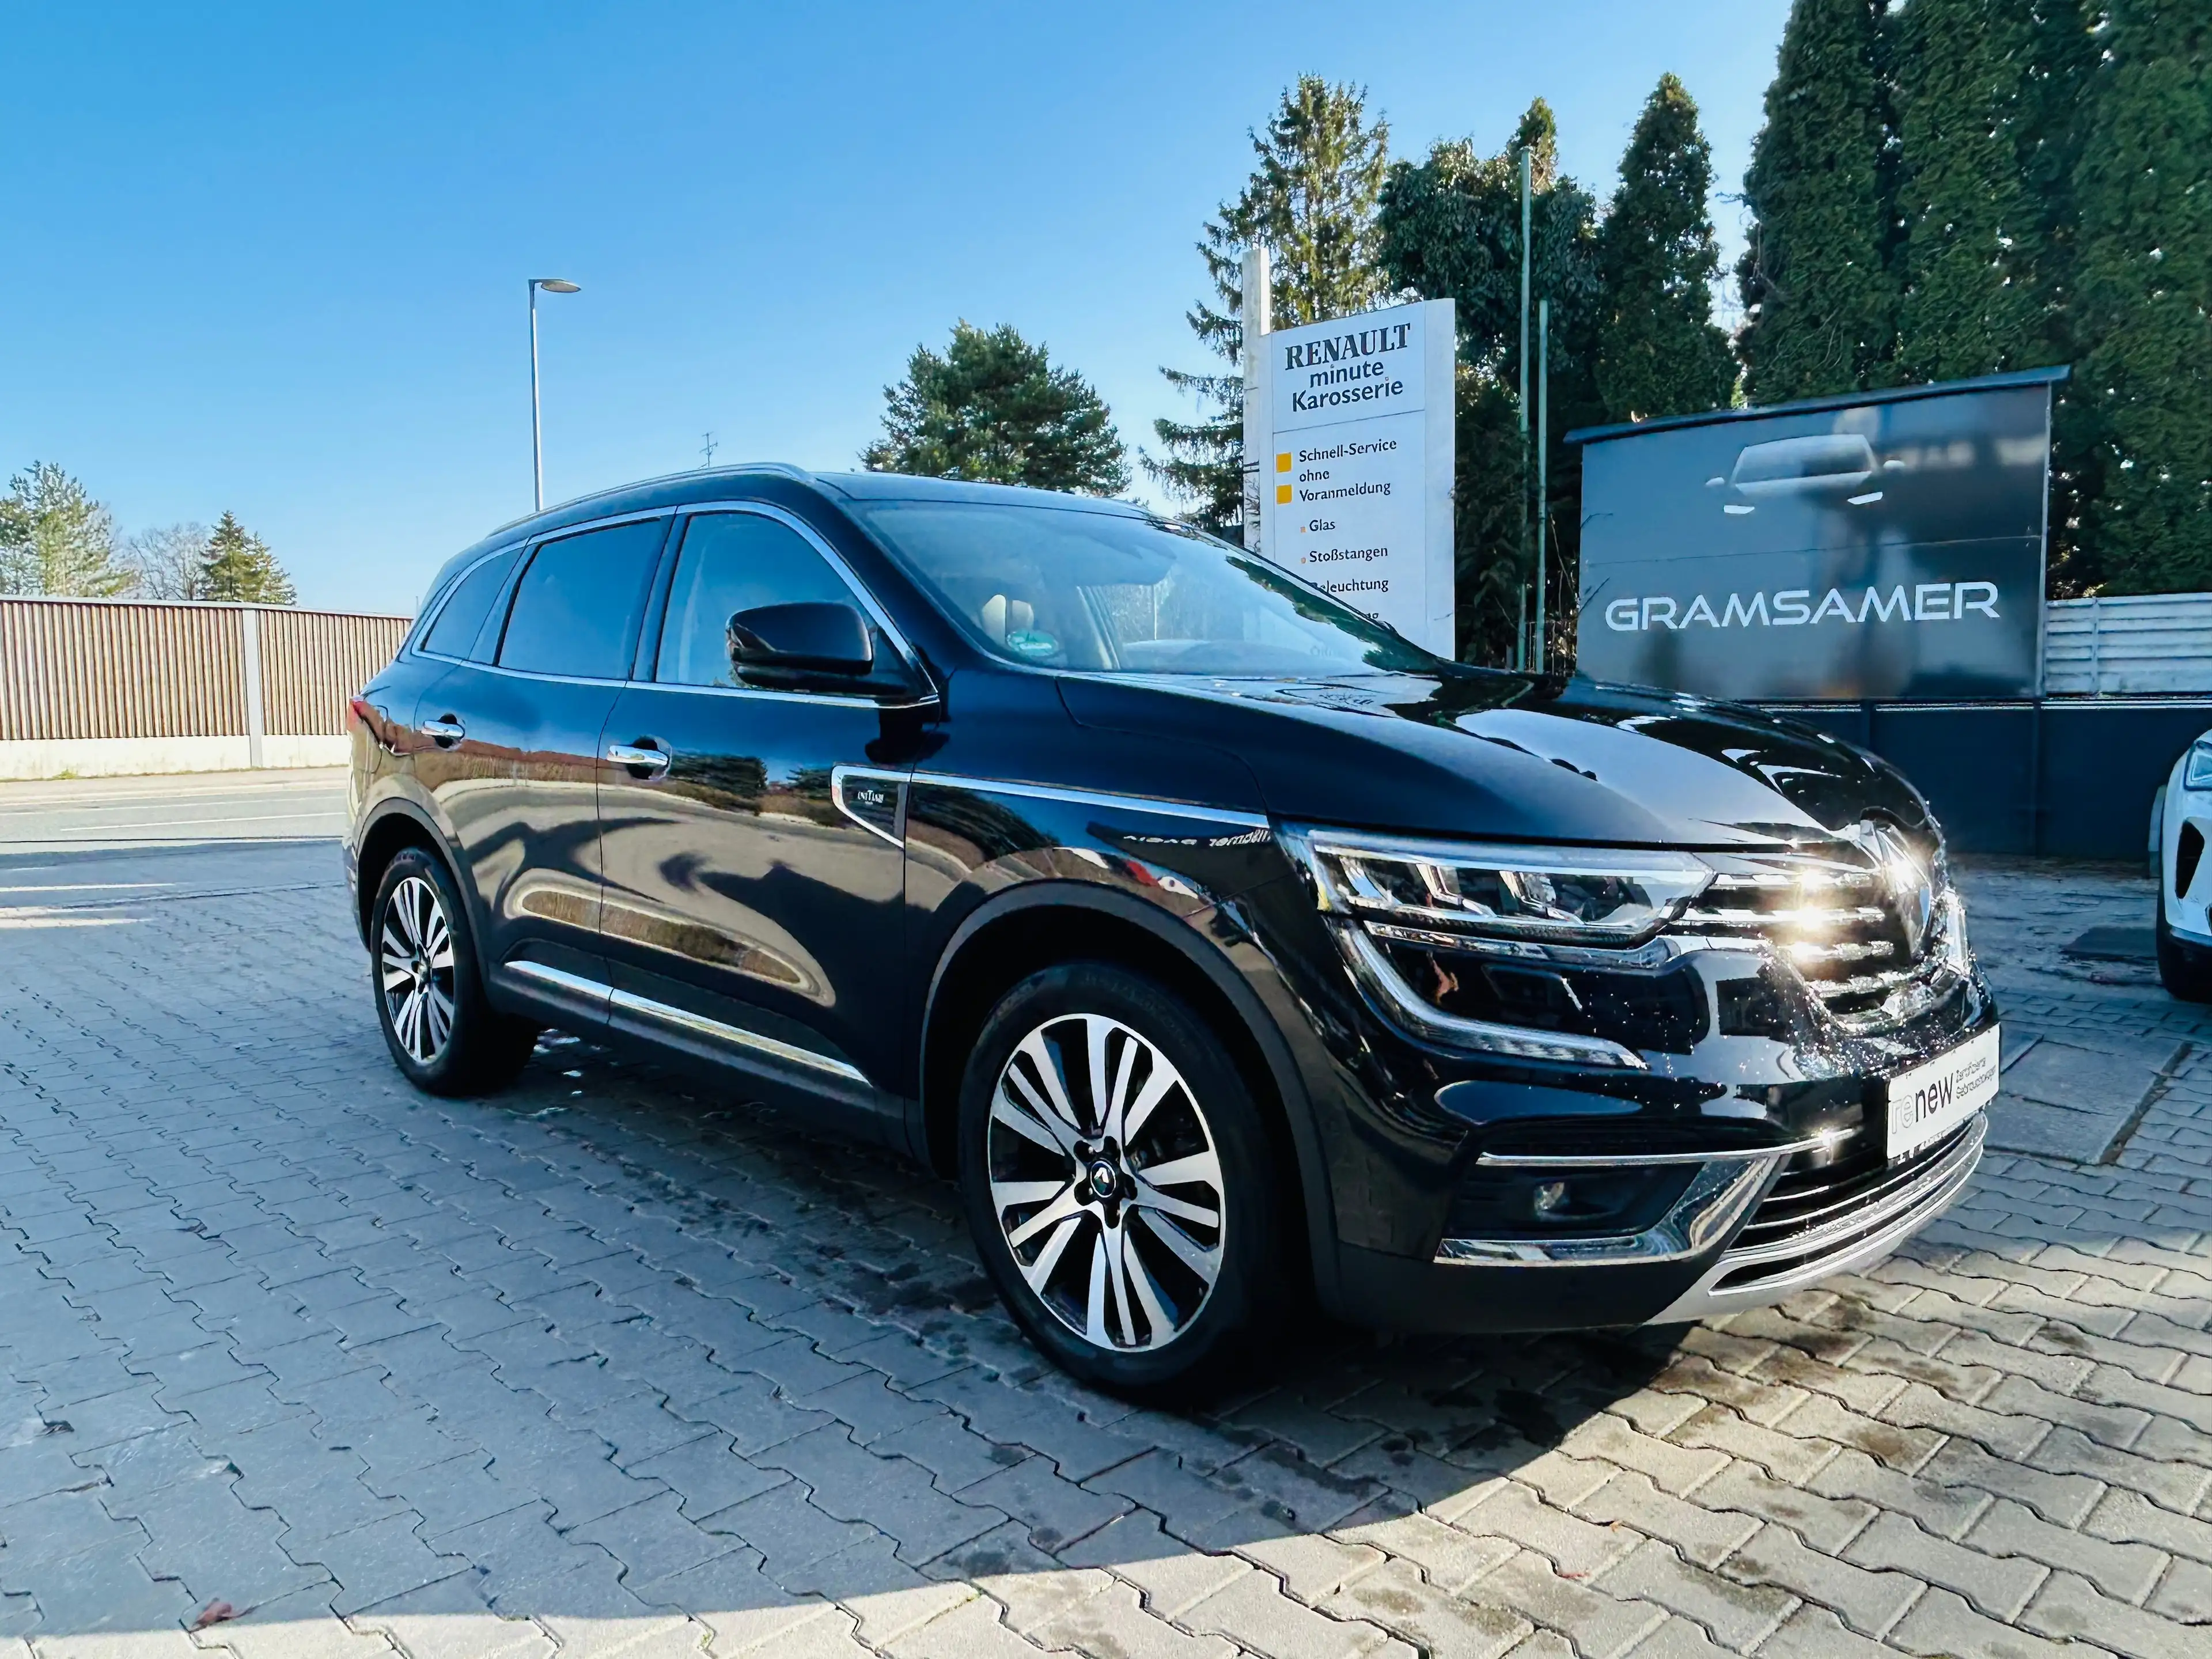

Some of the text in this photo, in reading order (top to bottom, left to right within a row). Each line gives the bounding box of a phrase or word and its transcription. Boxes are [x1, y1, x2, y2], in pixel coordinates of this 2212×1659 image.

[1285, 323, 1410, 370] RENAULT
[1310, 360, 1384, 388] minute
[1293, 377, 1403, 412] Karosserie
[1299, 439, 1397, 462] Schnell-Service
[1300, 469, 1330, 482] ohne
[1300, 482, 1391, 501] Voranmeldung
[1309, 519, 1336, 531] Glas
[1310, 547, 1388, 562] Stoßstangen
[1605, 581, 2001, 631] GRAMSAMER
